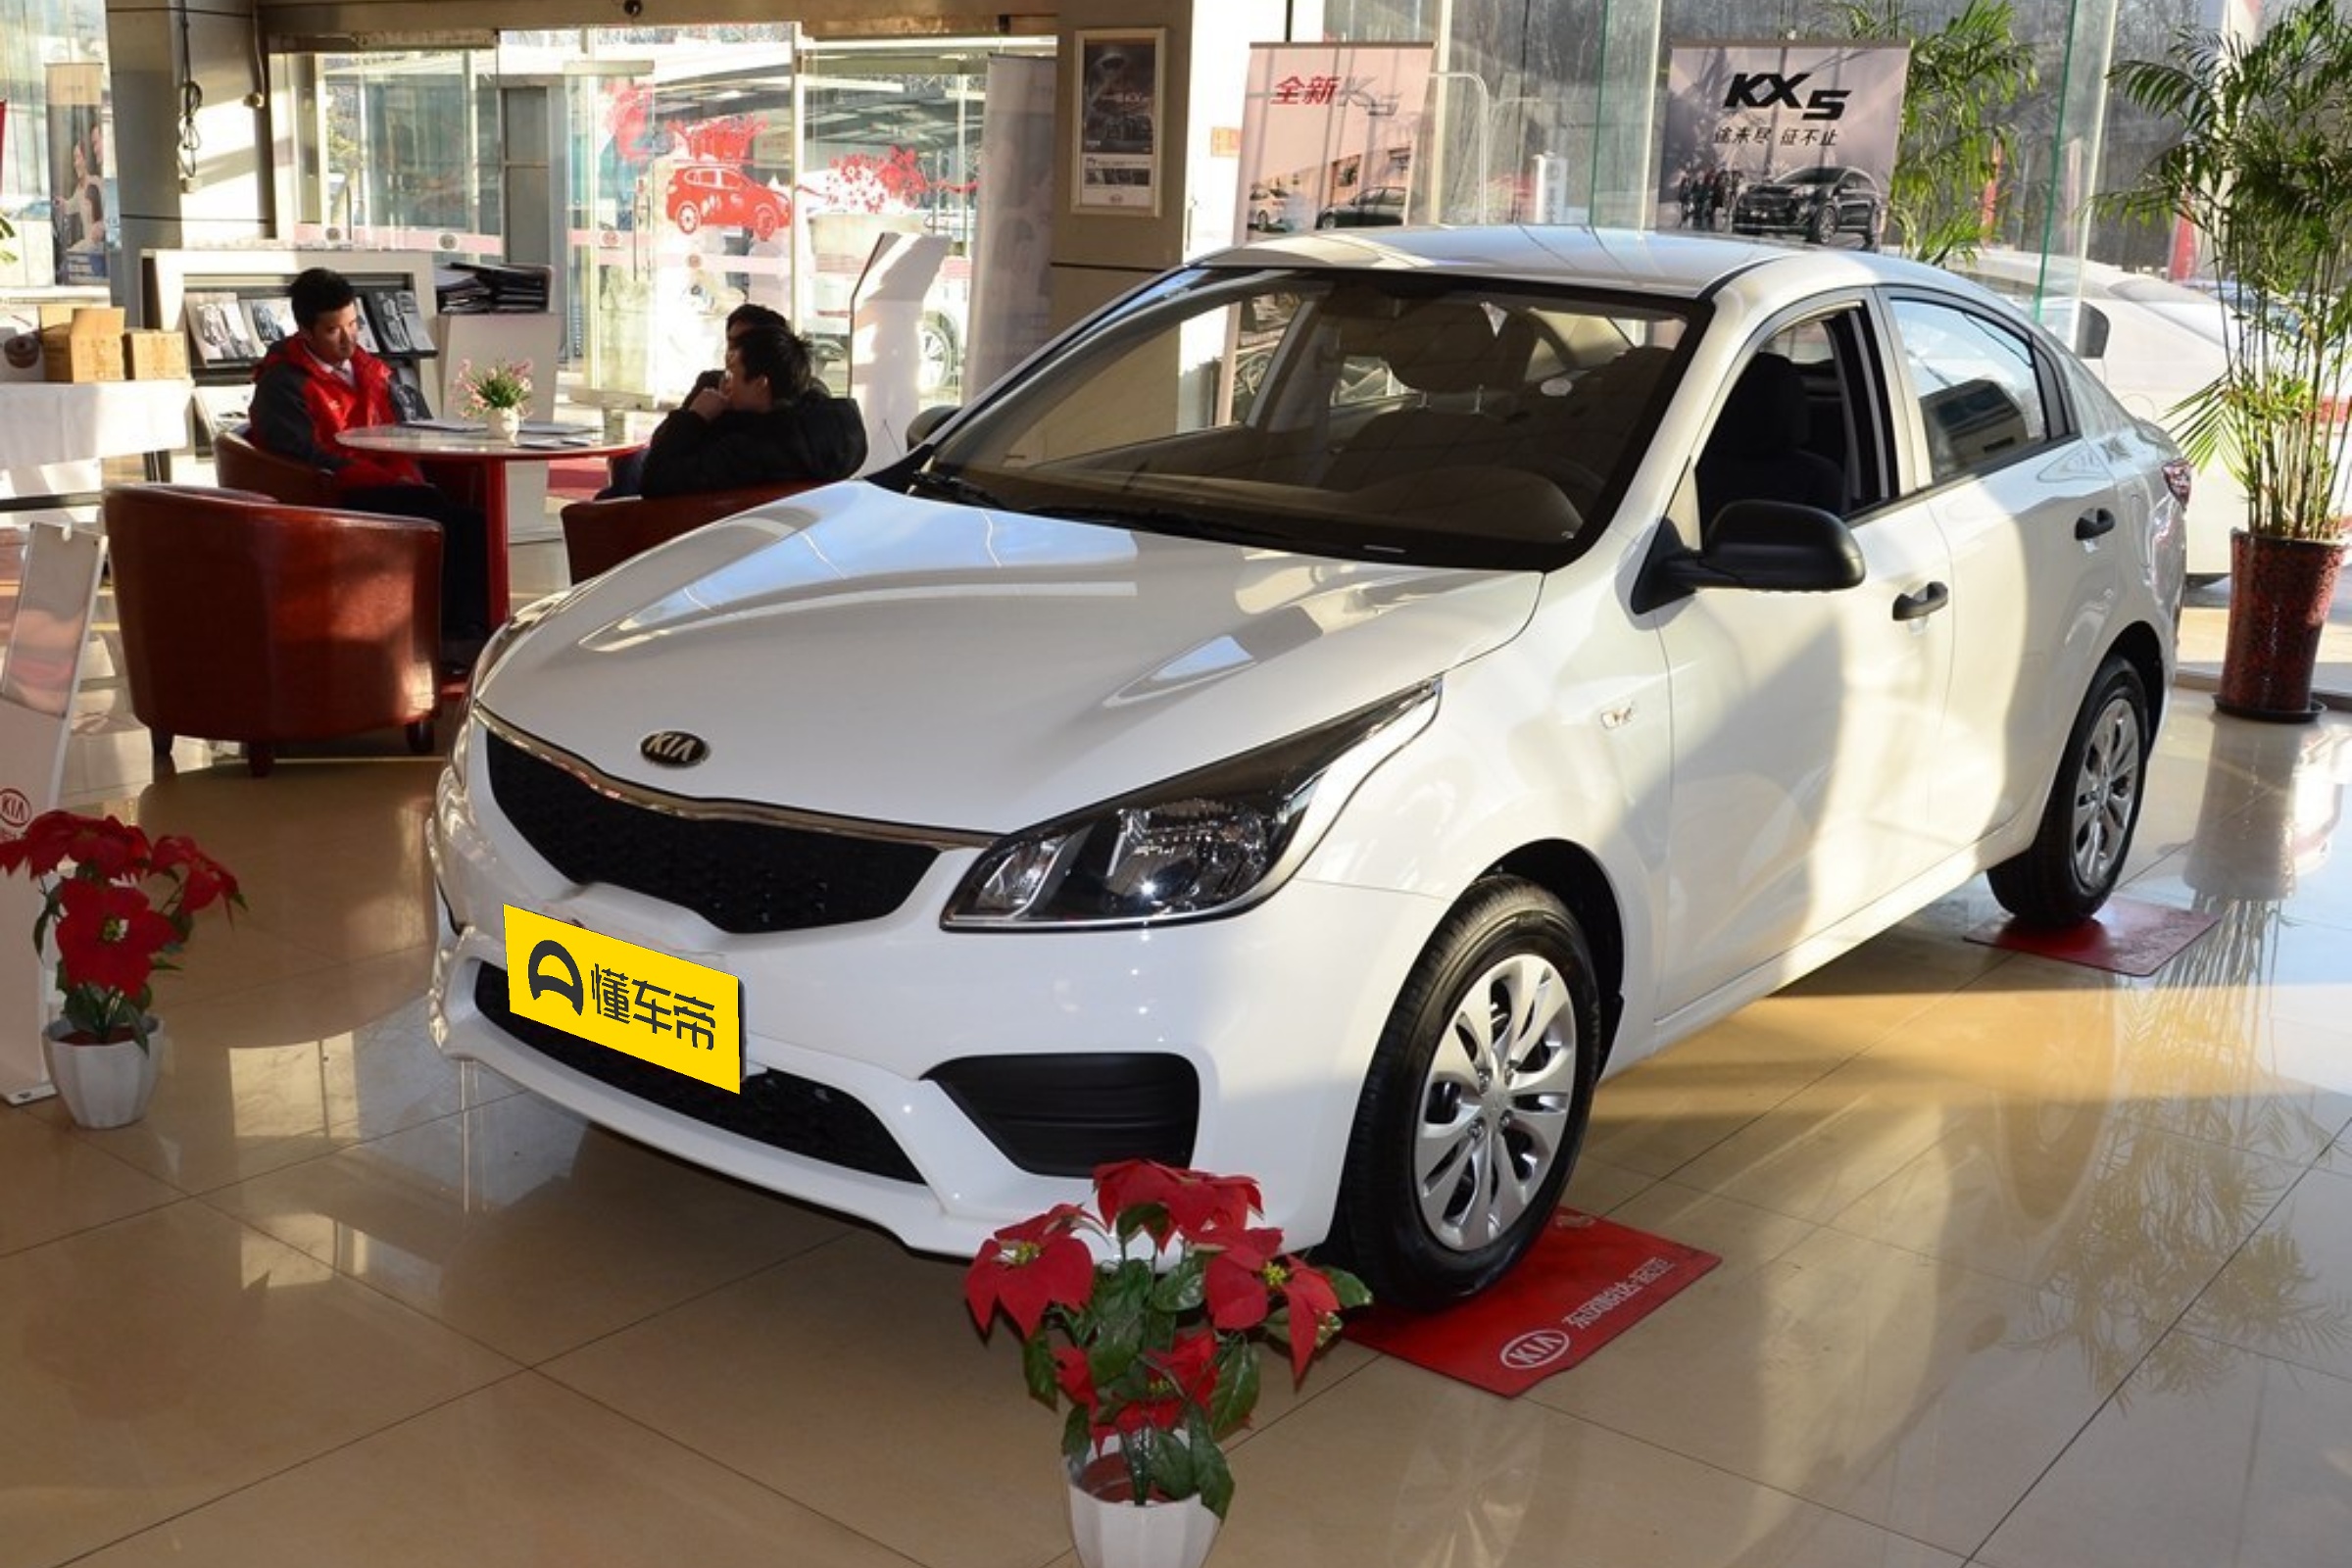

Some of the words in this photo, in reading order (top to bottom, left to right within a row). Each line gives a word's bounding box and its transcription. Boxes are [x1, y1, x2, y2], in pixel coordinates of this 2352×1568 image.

[1724, 73, 1851, 120] KX5
[645, 732, 697, 762] KIA
[1507, 1334, 1563, 1364] KIA
